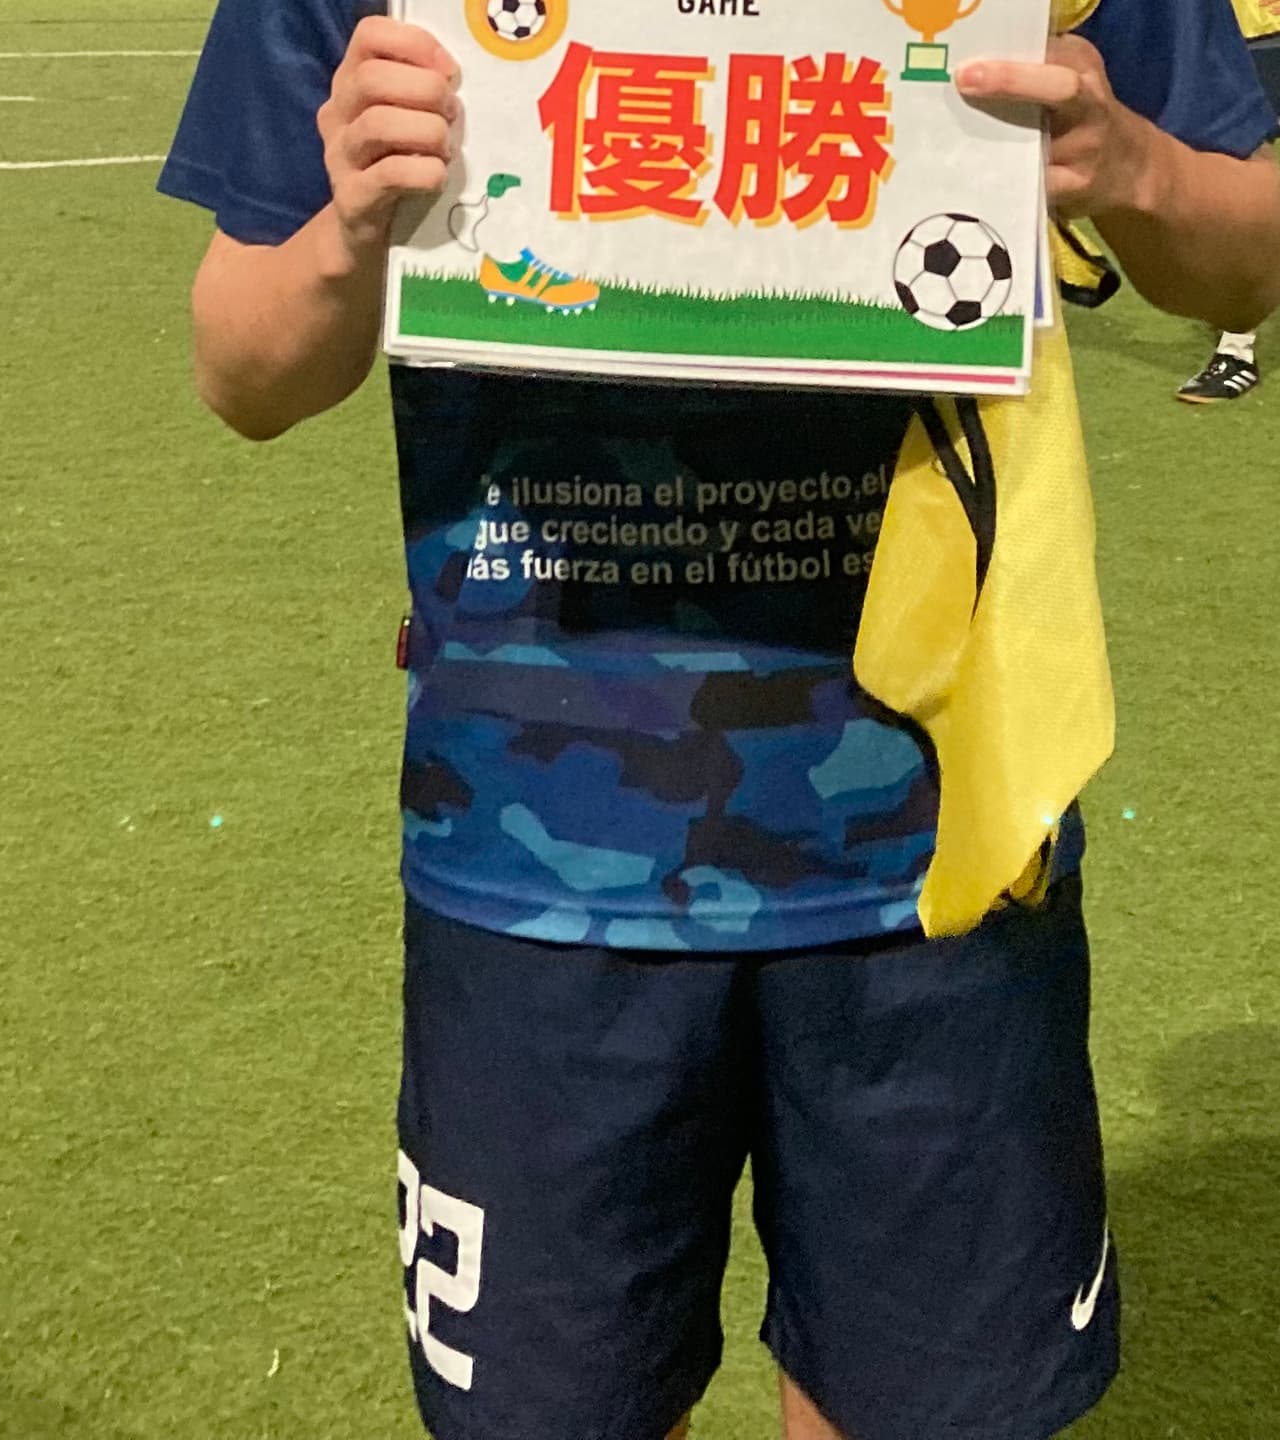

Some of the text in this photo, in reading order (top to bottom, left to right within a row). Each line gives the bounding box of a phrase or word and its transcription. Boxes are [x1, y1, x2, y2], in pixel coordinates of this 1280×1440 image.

[537, 41, 893, 229] 優勝
[512, 474, 642, 507] ilusiona
[654, 475, 683, 506] el
[541, 515, 708, 546] creciendo
[719, 520, 739, 553] y
[751, 511, 836, 544] cada
[466, 552, 511, 581] ás
[520, 548, 619, 583] fuerza
[631, 560, 673, 585] en
[685, 553, 715, 584] el
[728, 549, 831, 584] fútbol
